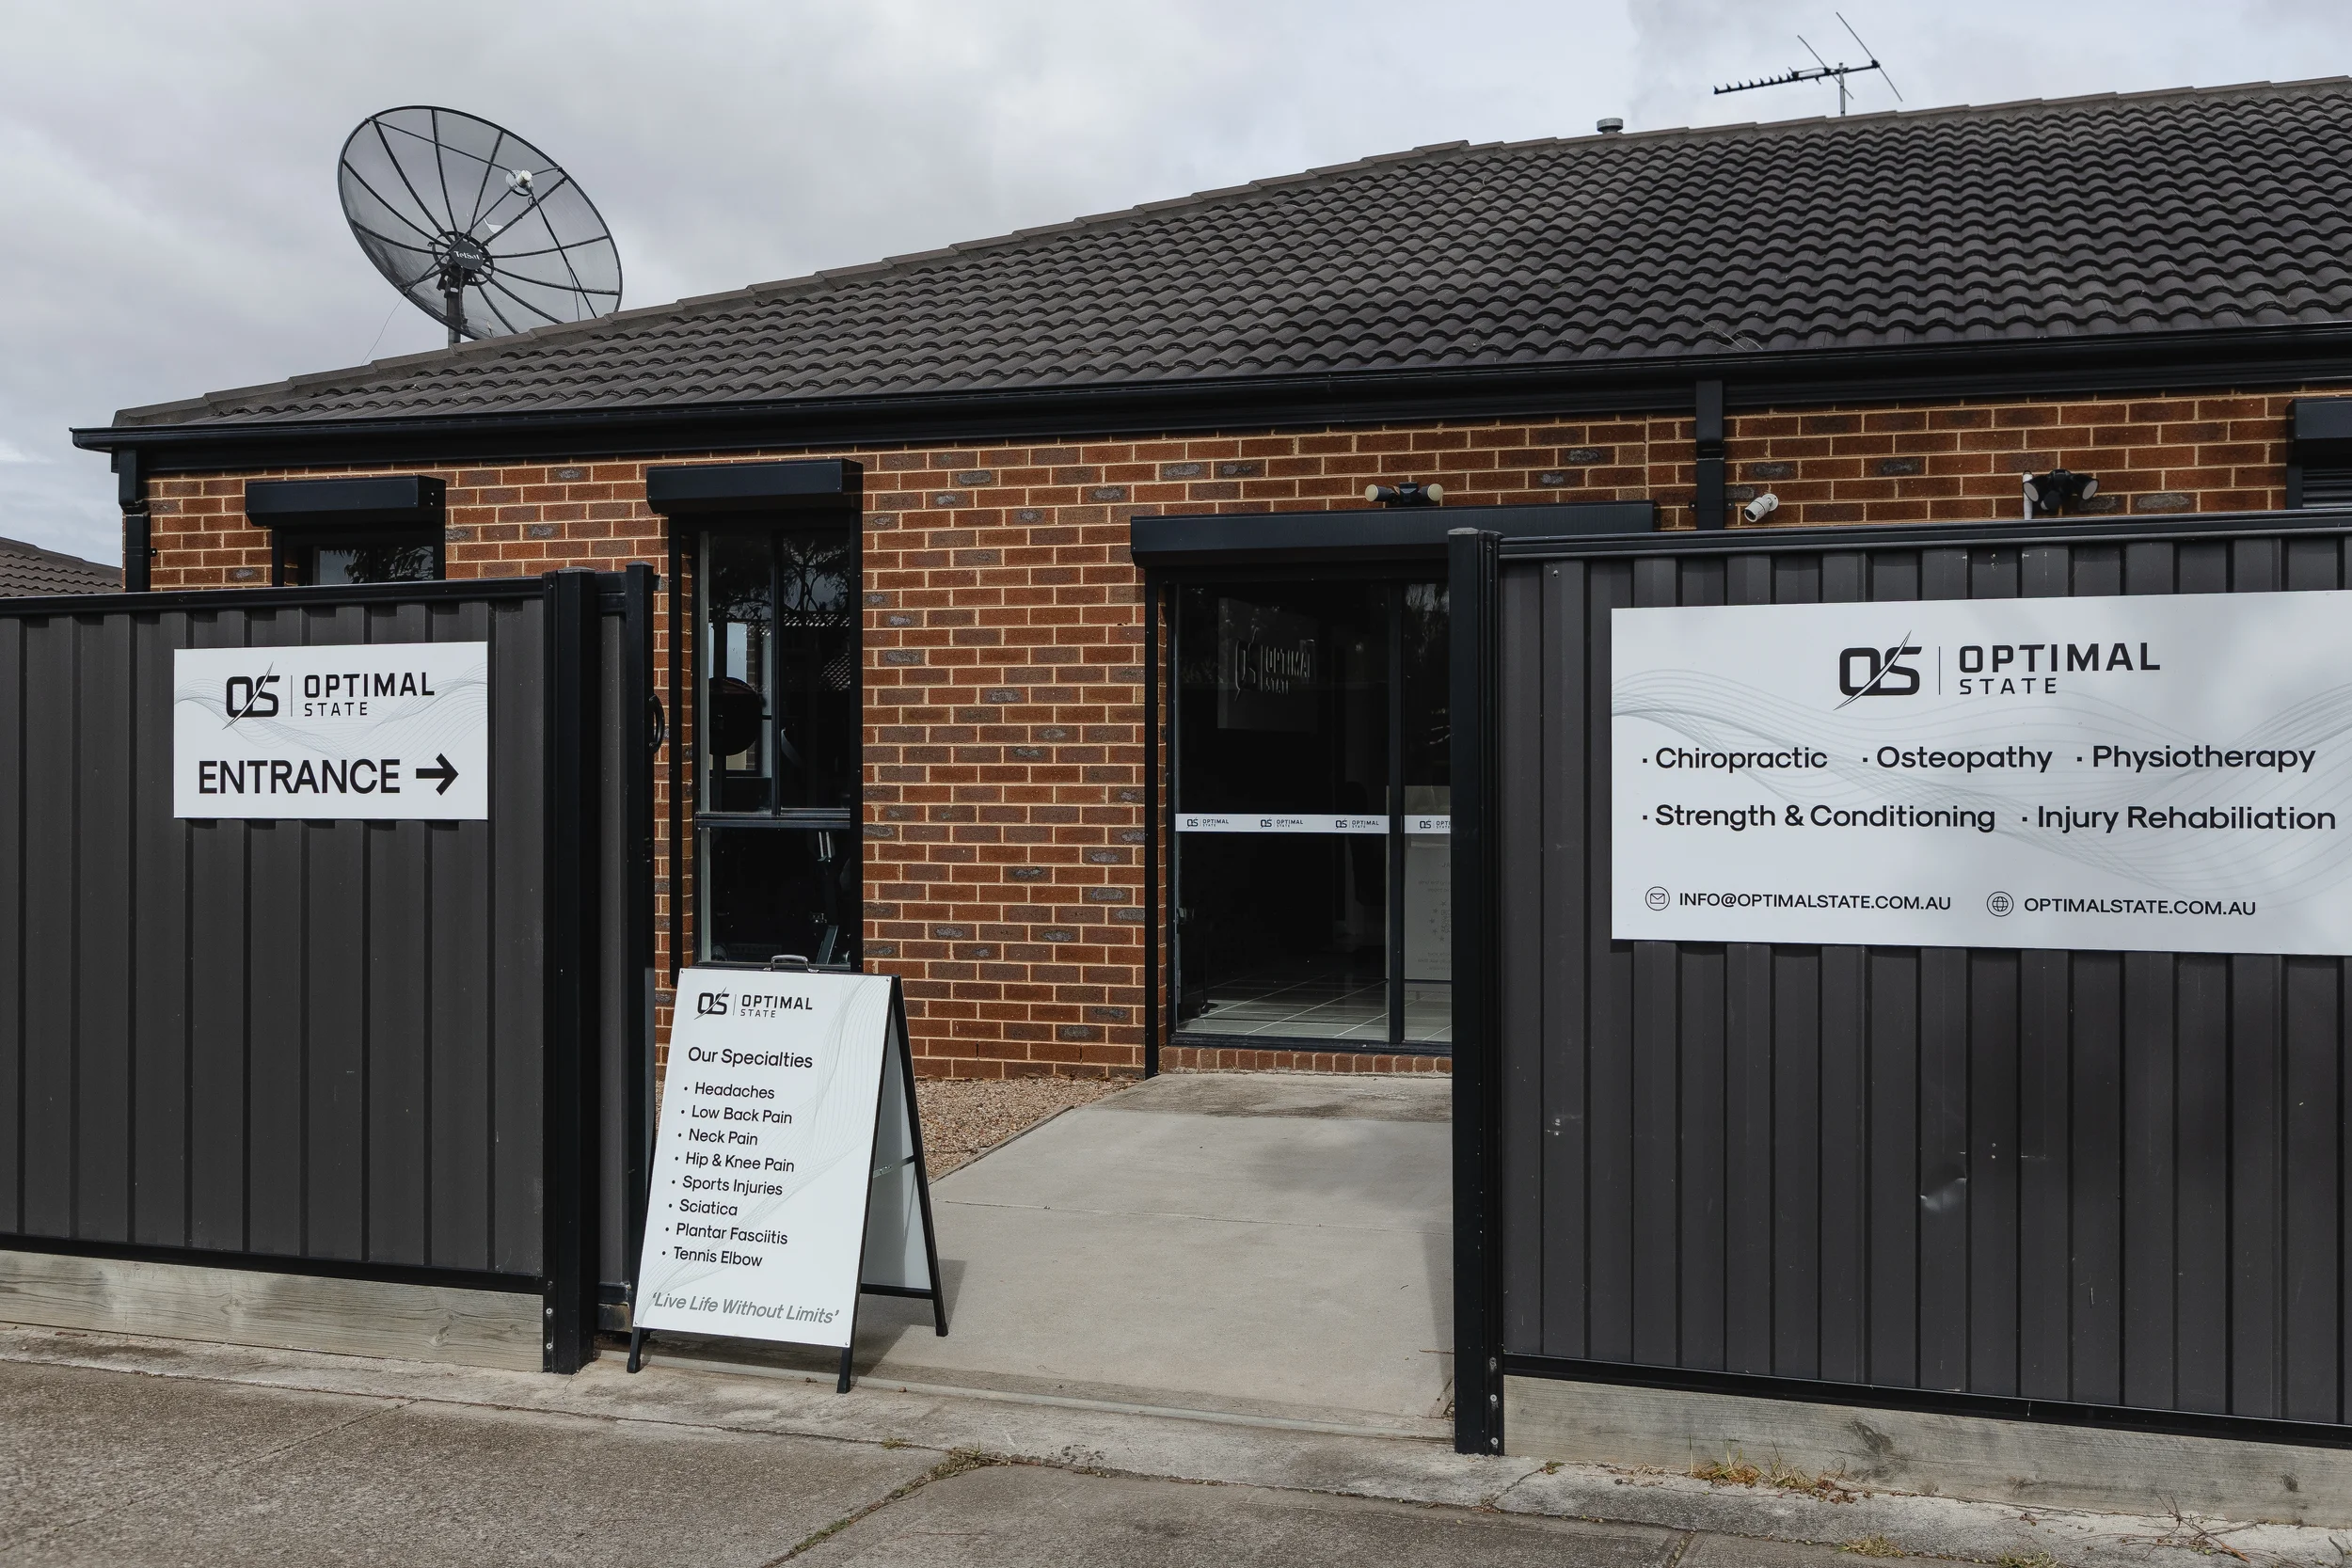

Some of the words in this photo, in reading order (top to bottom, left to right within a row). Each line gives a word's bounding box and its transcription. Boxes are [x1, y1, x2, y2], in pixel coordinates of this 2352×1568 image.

[1959, 641, 2161, 673] OPTIMAL
[304, 672, 436, 699] OPTIMAL
[1959, 677, 2058, 695] STATE
[304, 702, 368, 717] STATE
[1656, 746, 1828, 774] Chiropractic
[1876, 745, 2053, 773] Osteopathy
[2093, 744, 2316, 773] Physiotherapy
[199, 758, 401, 795] ENTRANCE
[1655, 803, 1775, 832] Strength
[1784, 804, 1804, 827] &
[1810, 804, 1995, 833] Conditioning
[2038, 805, 2120, 834] Injury
[2127, 805, 2336, 830] Rehabiliation
[1678, 892, 1952, 911] INFO@OPTIMALSTATE.COM.AU
[2023, 897, 2256, 916] OPTIMALSTATE.COM.AU
[740, 994, 813, 1011] OPTIMAL
[739, 1008, 776, 1019] STATE
[688, 1046, 719, 1063] Our
[721, 1048, 813, 1069] Specialties
[694, 1081, 775, 1100] Headaches
[691, 1104, 721, 1119] Low
[723, 1106, 760, 1122] Back
[762, 1109, 793, 1125] Pain
[688, 1128, 725, 1144] Neck
[727, 1131, 758, 1146] Pain
[685, 1150, 709, 1169] Hip
[711, 1153, 723, 1167] &
[724, 1154, 761, 1170] Knee
[764, 1157, 795, 1173] Pain
[682, 1175, 730, 1193] Sports
[733, 1179, 783, 1196] Injuries
[678, 1198, 739, 1216] Sciatica
[675, 1222, 727, 1240] Plantar
[729, 1227, 788, 1245] Fasciitis
[673, 1245, 718, 1263] Tennis
[720, 1250, 763, 1267] Elbow
[689, 1295, 719, 1312] Life
[723, 1298, 785, 1319] Without
